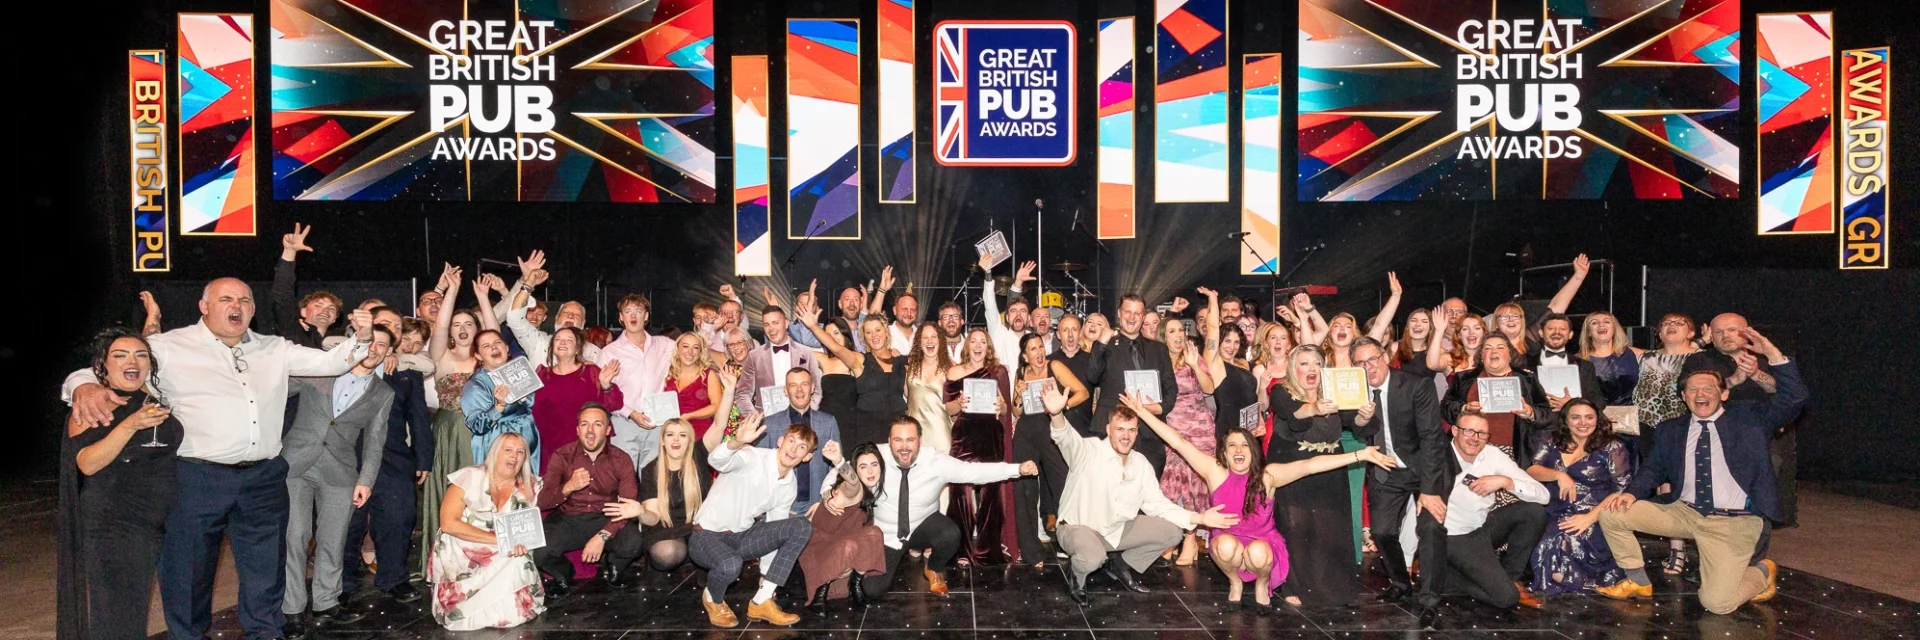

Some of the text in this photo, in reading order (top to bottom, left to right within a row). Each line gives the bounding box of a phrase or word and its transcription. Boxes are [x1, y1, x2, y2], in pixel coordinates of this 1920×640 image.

[429, 20, 554, 50] GREAT
[1457, 19, 1582, 49] GREAT
[429, 54, 555, 81] BRITISH
[979, 48, 1057, 68] GREAT
[1457, 53, 1582, 79] BRITISH
[979, 70, 1057, 87] BRITISH
[430, 85, 556, 133] PUB
[979, 89, 1057, 120] PUB
[1457, 83, 1582, 132] PUB
[979, 121, 1057, 137] AWARDS
[135, 80, 162, 212] BRITISH
[431, 137, 556, 161] AWARDS
[1457, 135, 1582, 159] AWARDS
[1847, 51, 1882, 264] AWARDS GR
[508, 370, 529, 384] PUB
[1338, 382, 1360, 391] PUB
[1493, 390, 1514, 398] PUB
[511, 523, 536, 536] PUB
